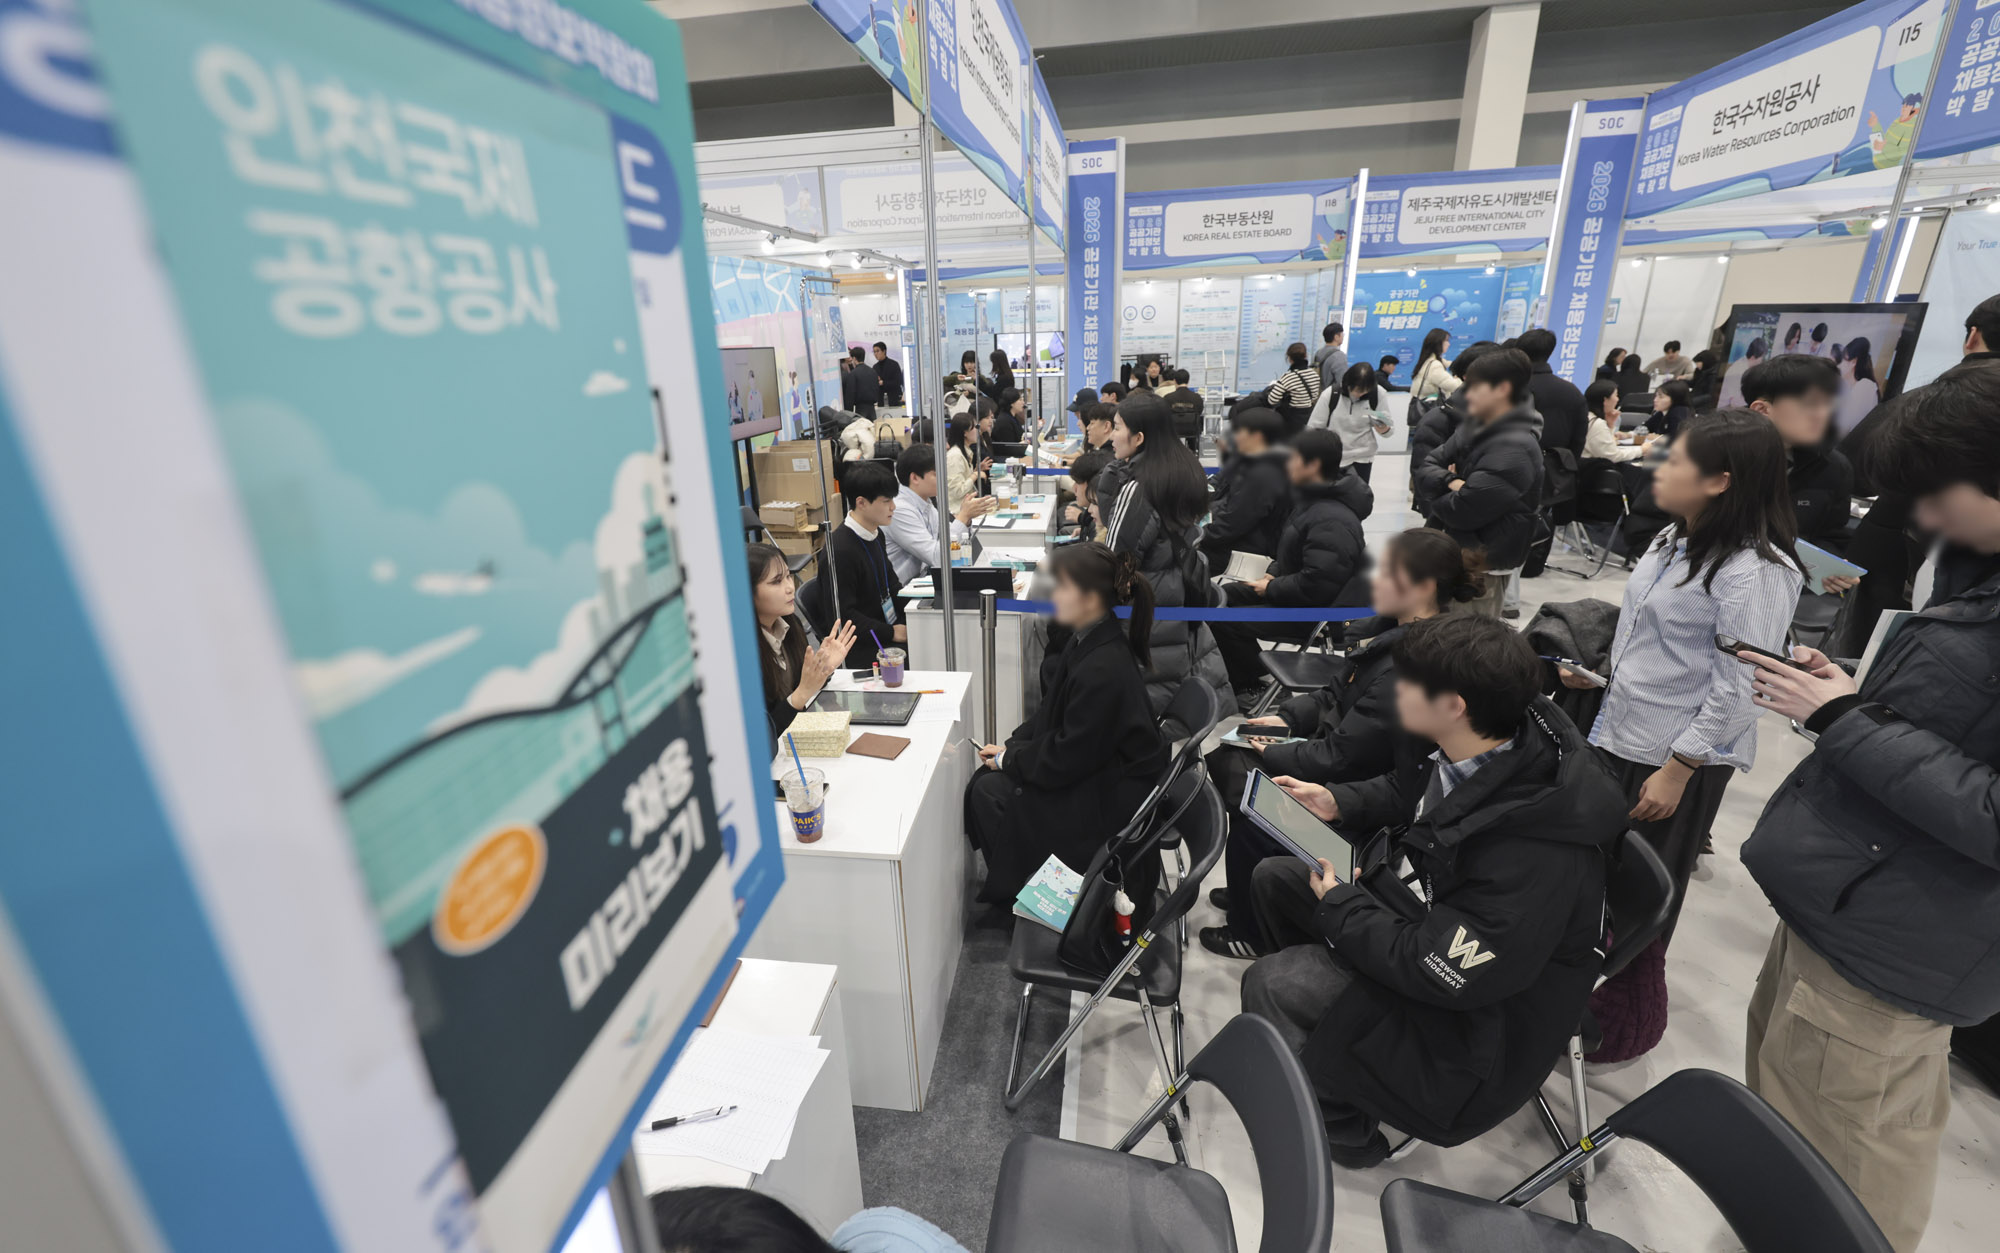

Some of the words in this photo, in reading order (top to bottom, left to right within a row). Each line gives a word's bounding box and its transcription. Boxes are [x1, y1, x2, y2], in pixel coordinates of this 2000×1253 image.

[1712, 74, 1820, 135] 한국수자원공사
[194, 42, 540, 229] 인천국제
[1598, 117, 1624, 129] SOC
[1677, 153, 1700, 167] Korea
[1702, 143, 1728, 160] Water
[1729, 127, 1781, 152] Resources
[1783, 105, 1855, 135] Corporation
[1082, 157, 1103, 168] SOC
[1407, 189, 1558, 212] 제주국제자유도시개발센터
[1586, 161, 1613, 212] 2026
[1083, 197, 1100, 243] 2026
[1202, 210, 1274, 228] 한국부동산원
[1414, 215, 1434, 225] JEJU
[1435, 214, 1456, 223] FREE
[1457, 211, 1522, 222] INTERNATIONAL
[1523, 209, 1545, 219] CITY
[1429, 223, 1491, 235] DEVELOPMENT
[1492, 222, 1526, 232] CENTER
[1129, 228, 1161, 237] 공공기관
[1183, 233, 1209, 242] KOREA
[1210, 231, 1231, 241] REAL
[1232, 229, 1262, 240] ESTATE
[1263, 228, 1292, 238] BOARD
[1957, 241, 1977, 251] Your
[1978, 240, 1998, 250] True
[1573, 217, 1603, 288] 공공기관
[245, 207, 560, 338] 공항공사
[1083, 247, 1099, 311] 공공기관
[1373, 300, 1429, 315] 채용정보
[1389, 289, 1420, 299] 공공기관
[1379, 315, 1422, 330] 박람회
[623, 738, 694, 849] 채용
[793, 813, 821, 825] PAIK'S
[560, 797, 705, 1012] 미리보기
[1447, 925, 1496, 970] W
[1423, 956, 1462, 989] HIDEAWAY
[1429, 952, 1467, 985] LIFEWORK
